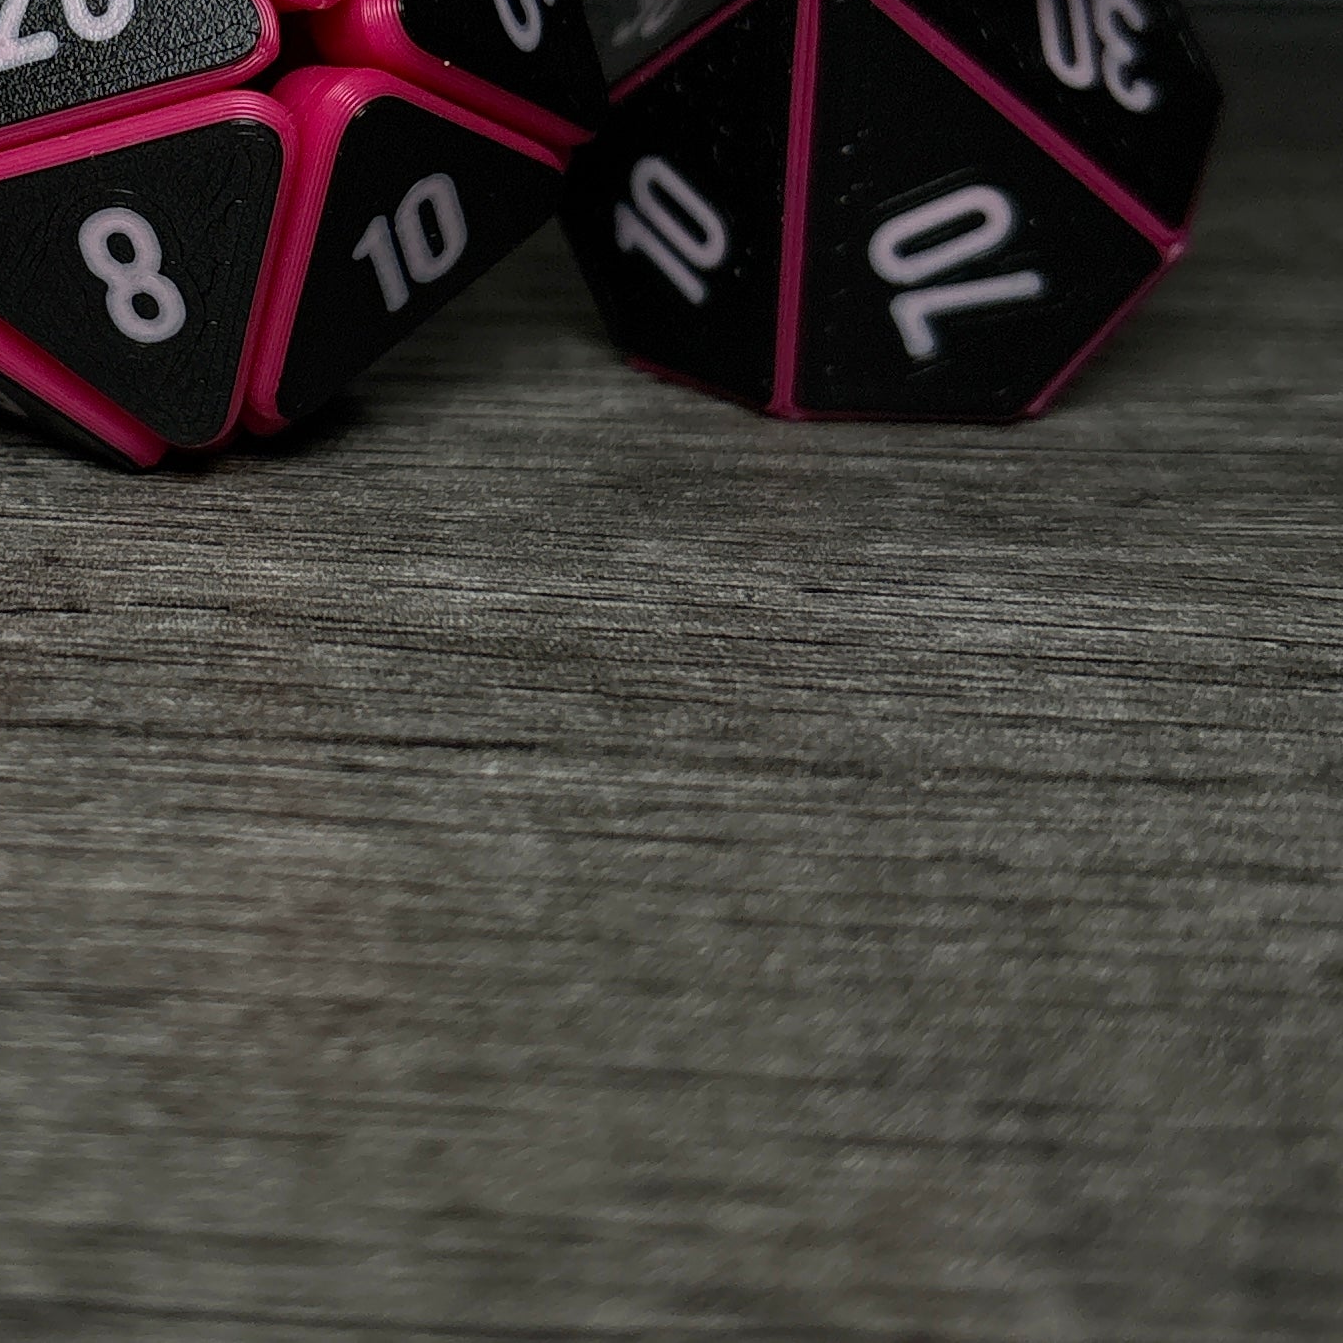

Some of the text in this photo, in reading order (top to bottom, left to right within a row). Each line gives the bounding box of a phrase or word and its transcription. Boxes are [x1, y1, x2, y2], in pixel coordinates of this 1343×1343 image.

[78, 206, 187, 344] 8
[351, 172, 467, 312] 10
[617, 157, 727, 304] 10
